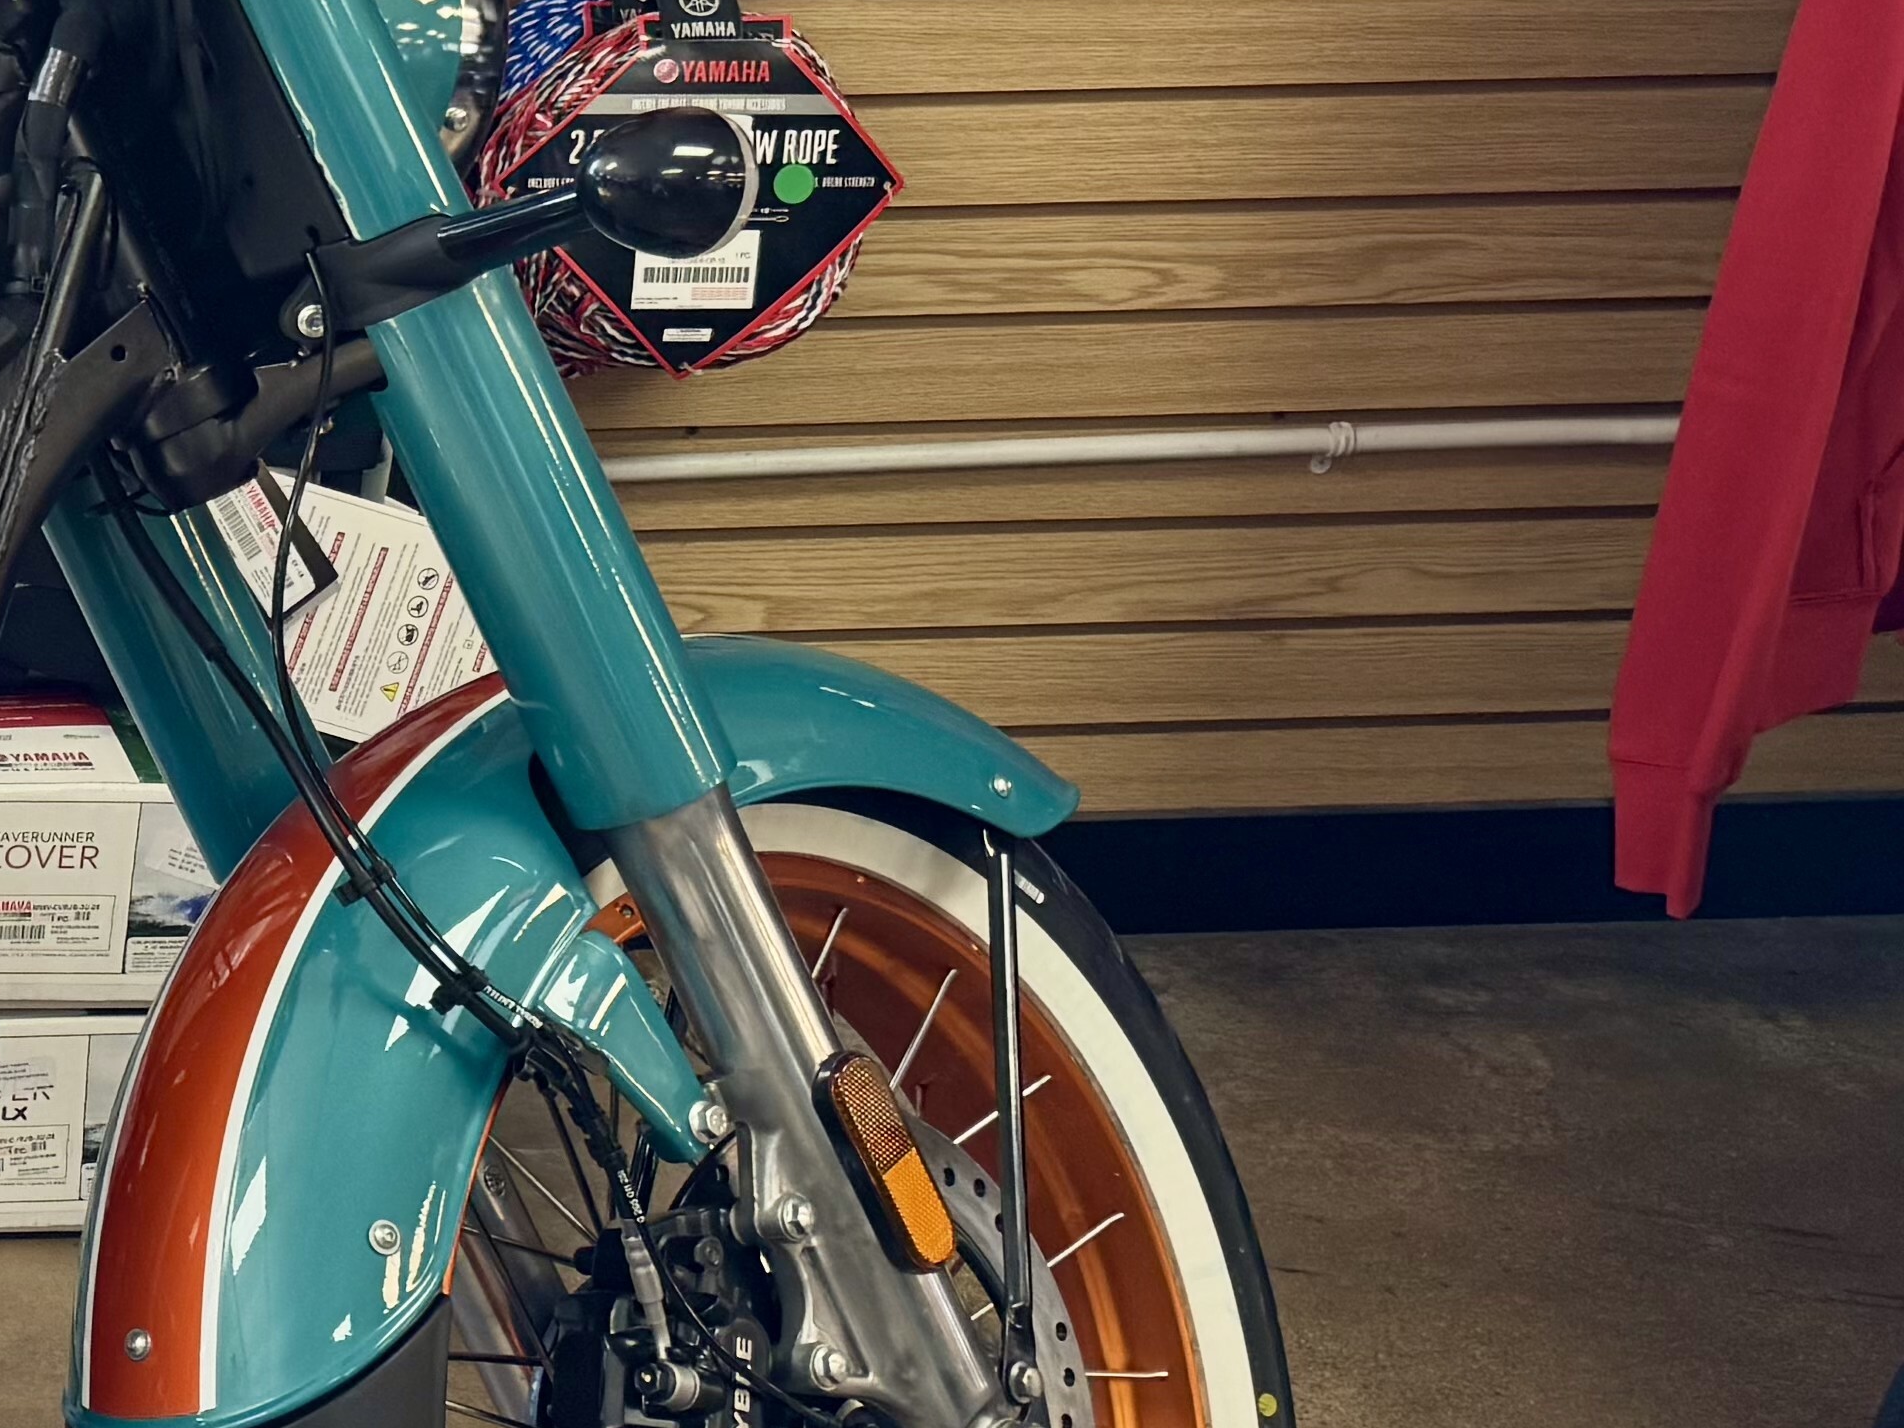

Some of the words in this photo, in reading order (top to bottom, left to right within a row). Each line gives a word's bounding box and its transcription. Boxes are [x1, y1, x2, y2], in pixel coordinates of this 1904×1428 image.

[671, 21, 736, 38] YAMAHA
[682, 61, 770, 83] YAMAHA
[783, 129, 840, 165] ROPE
[246, 486, 276, 530] YAMAHA
[9, 752, 89, 761] YAMAHA
